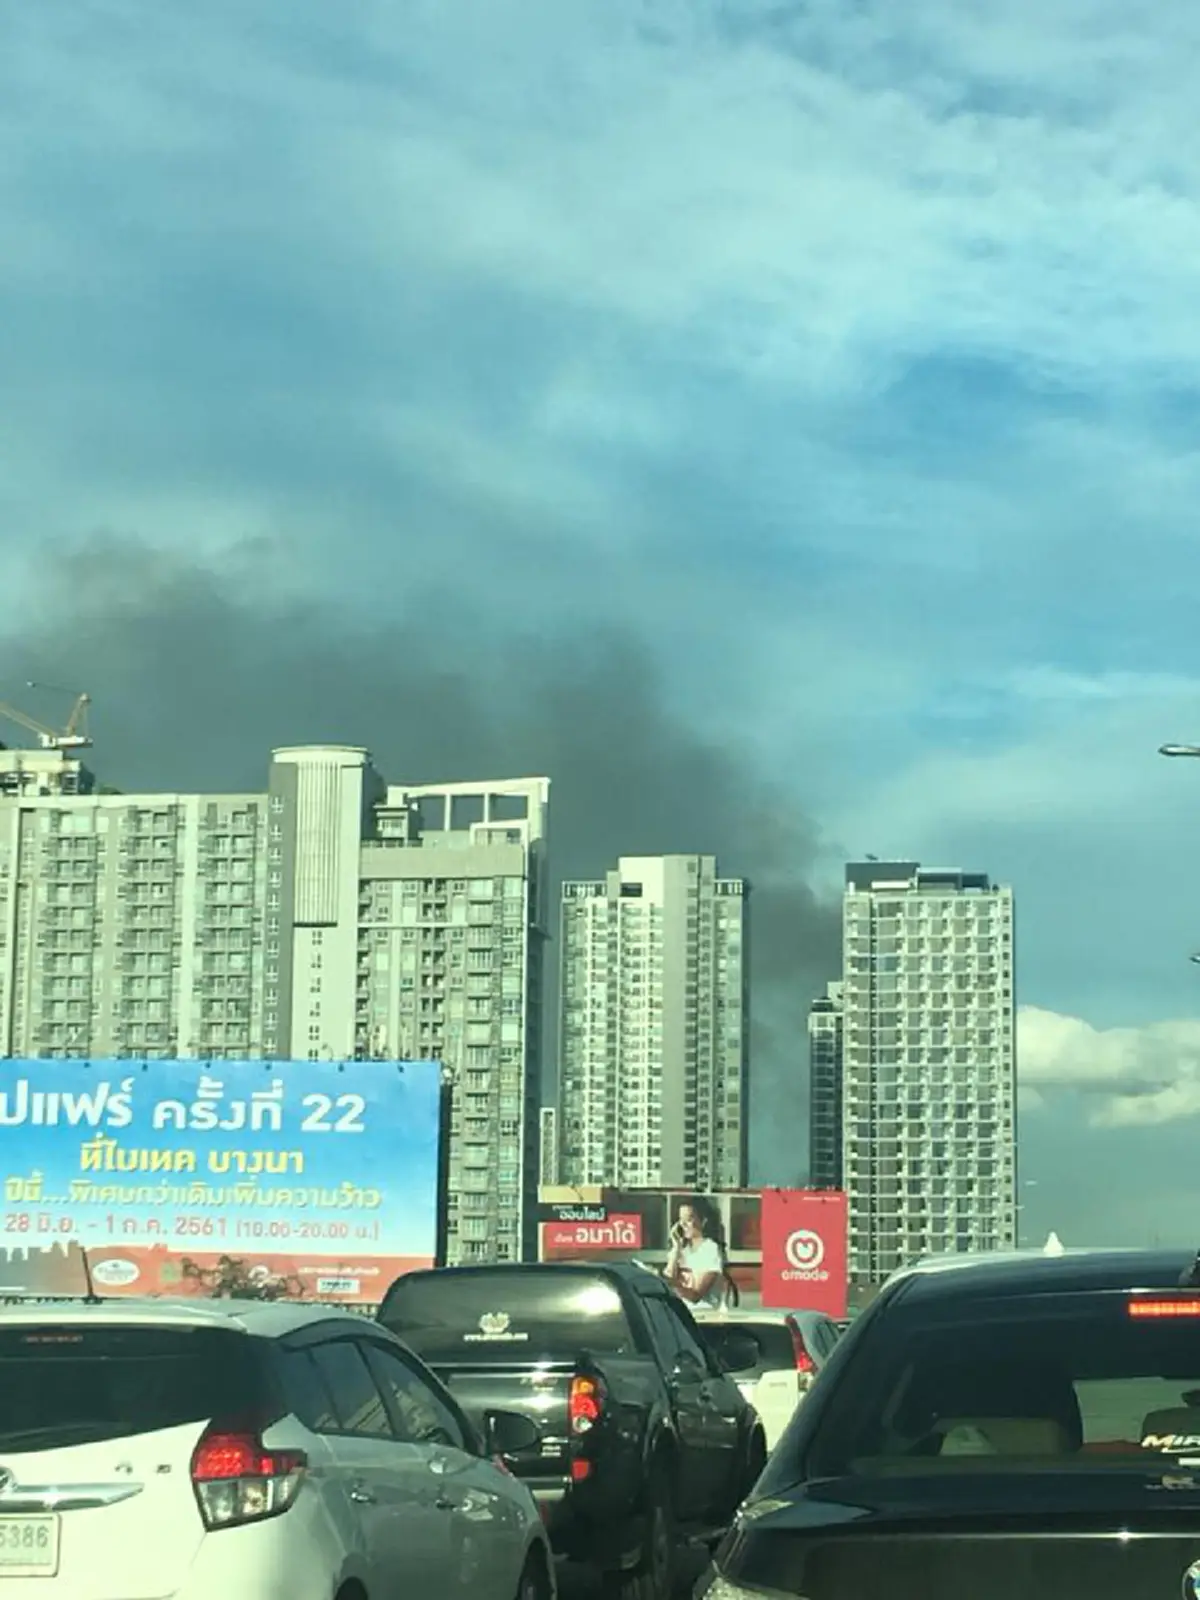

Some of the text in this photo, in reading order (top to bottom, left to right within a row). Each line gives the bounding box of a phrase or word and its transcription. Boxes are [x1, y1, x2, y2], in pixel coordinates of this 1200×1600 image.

[152, 1076, 283, 1131] ครั้งที่
[301, 1094, 365, 1132] 22
[80, 1132, 304, 1174] ที่ไบเทค บางนา
[4, 1213, 30, 1233] 28
[106, 1214, 114, 1234] 1
[174, 1216, 228, 1236] 2561
[575, 1220, 637, 1244] อมาโด้
